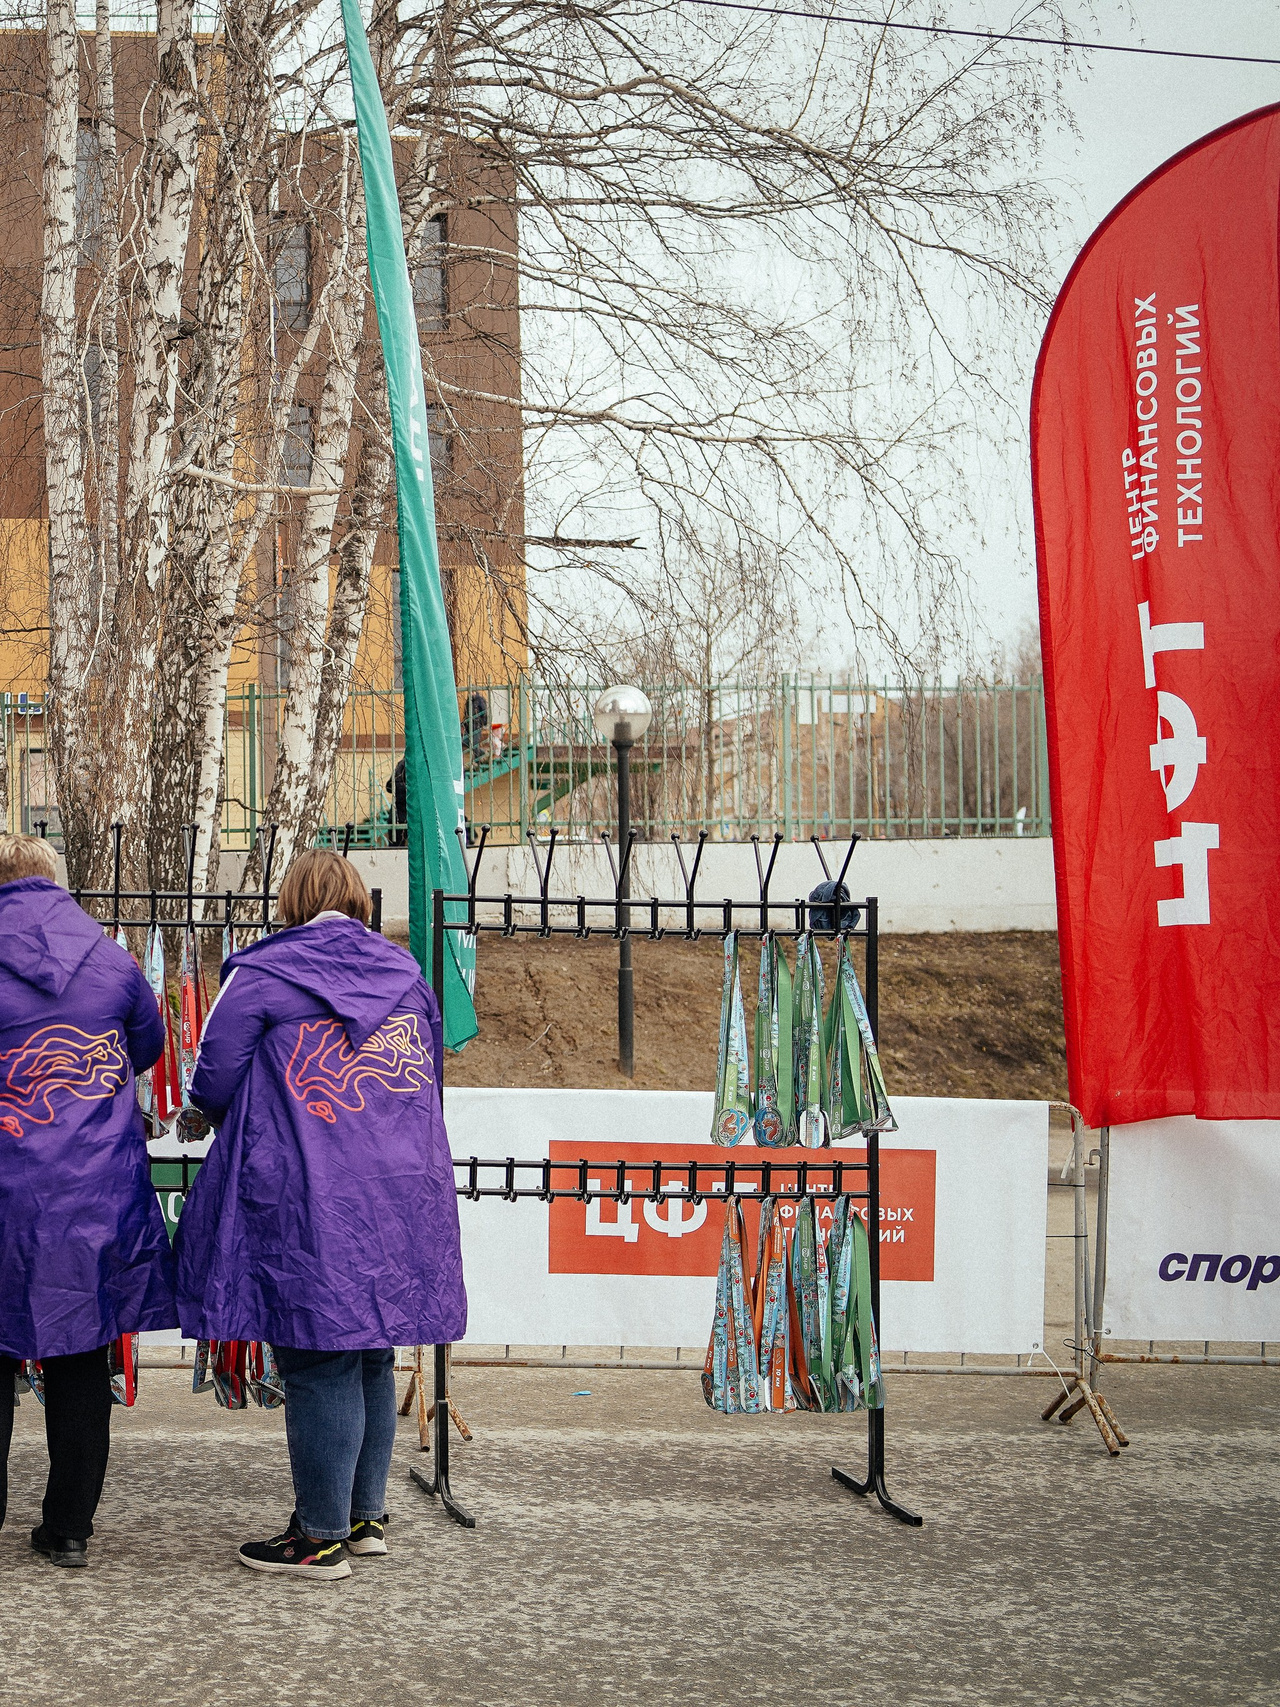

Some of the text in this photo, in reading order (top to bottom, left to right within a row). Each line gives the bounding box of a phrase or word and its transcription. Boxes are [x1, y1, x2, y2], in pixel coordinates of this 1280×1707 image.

[1122, 447, 1144, 560] ЦЕНТР
[1134, 292, 1160, 553] ФИНАНСОВЫХ
[1166, 303, 1204, 548] ТЕХНОЛОГИЙ
[1138, 601, 1220, 927] ЦФТ
[1158, 1252, 1280, 1291] спор
